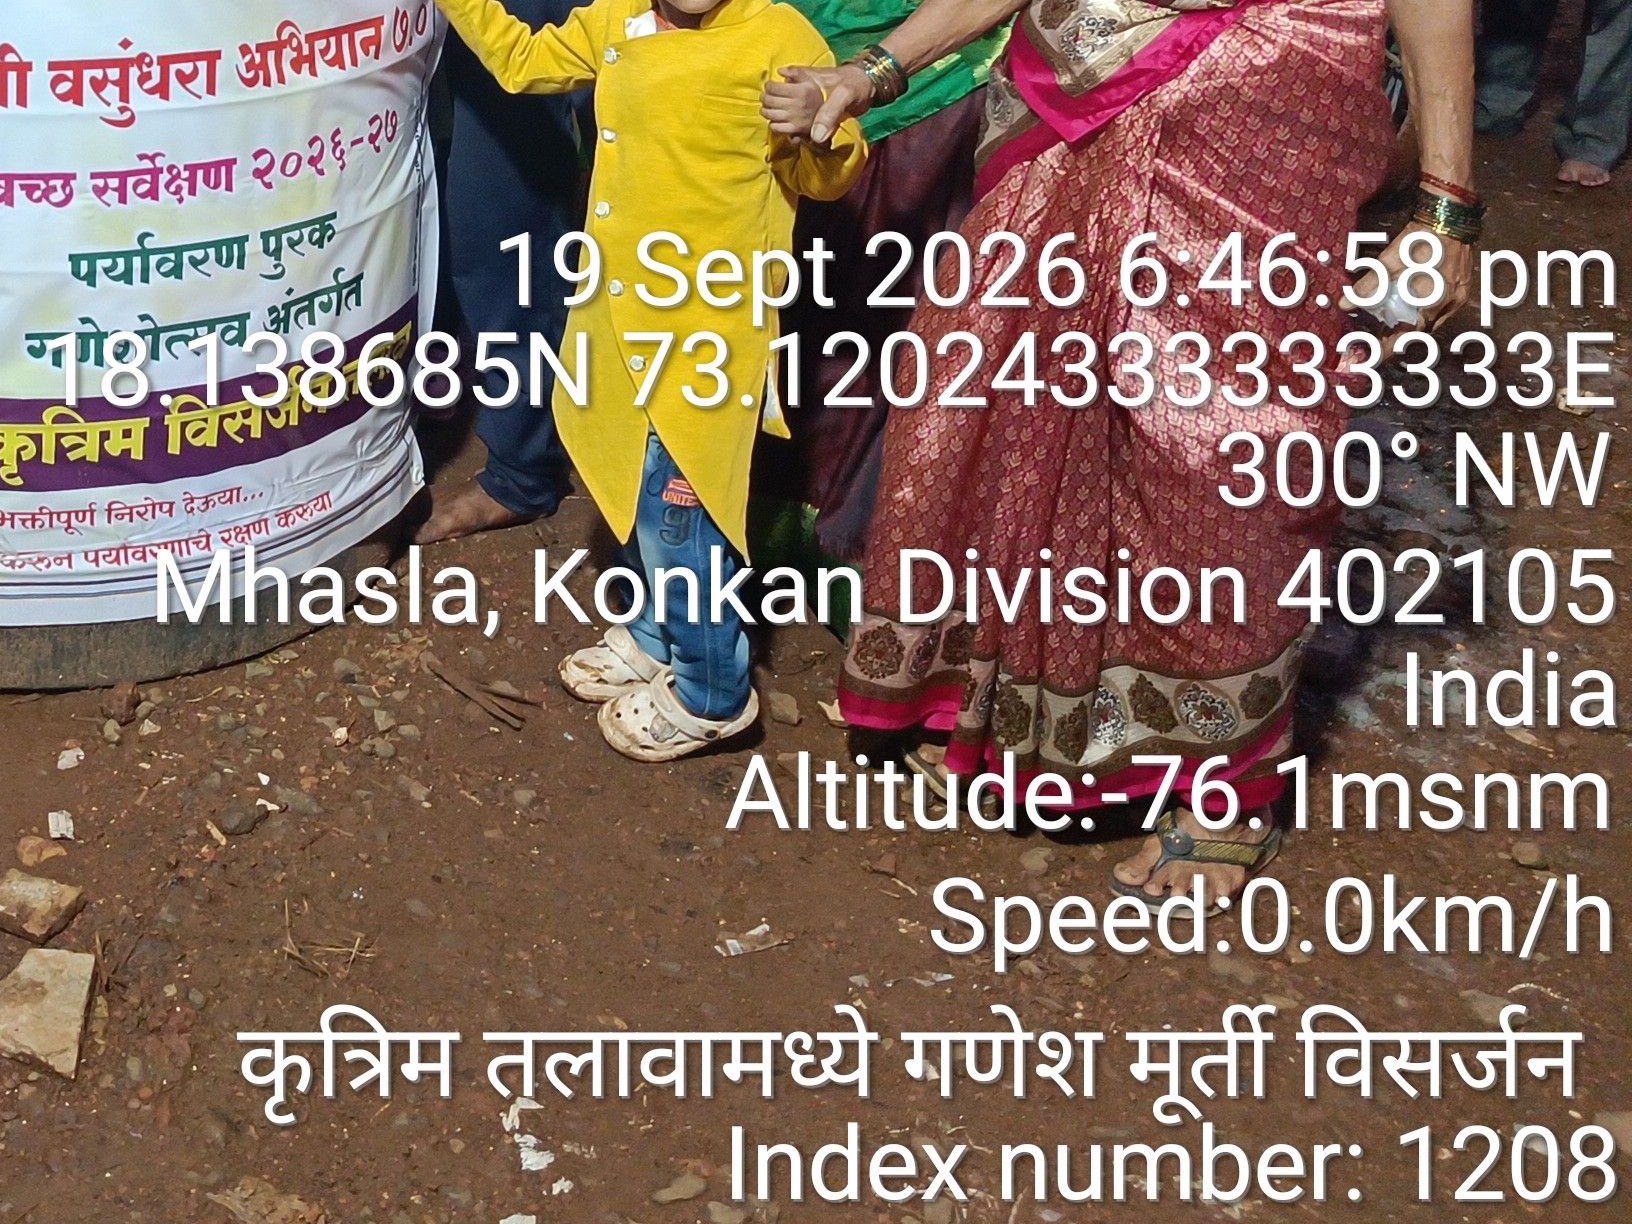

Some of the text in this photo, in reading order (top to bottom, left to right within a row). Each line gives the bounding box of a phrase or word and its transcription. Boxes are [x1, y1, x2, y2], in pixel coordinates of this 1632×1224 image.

[48, 37, 222, 129] वसुंधरा
[235, 15, 385, 89] अभियान
[90, 152, 237, 206] सर्वेक्षण
[251, 108, 398, 190] २०२६-२७
[68, 210, 338, 288] पर्यावरण पुरक
[263, 266, 365, 336] अंतर्गत
[106, 496, 176, 524] निरोप
[219, 518, 272, 547] रक्षण
